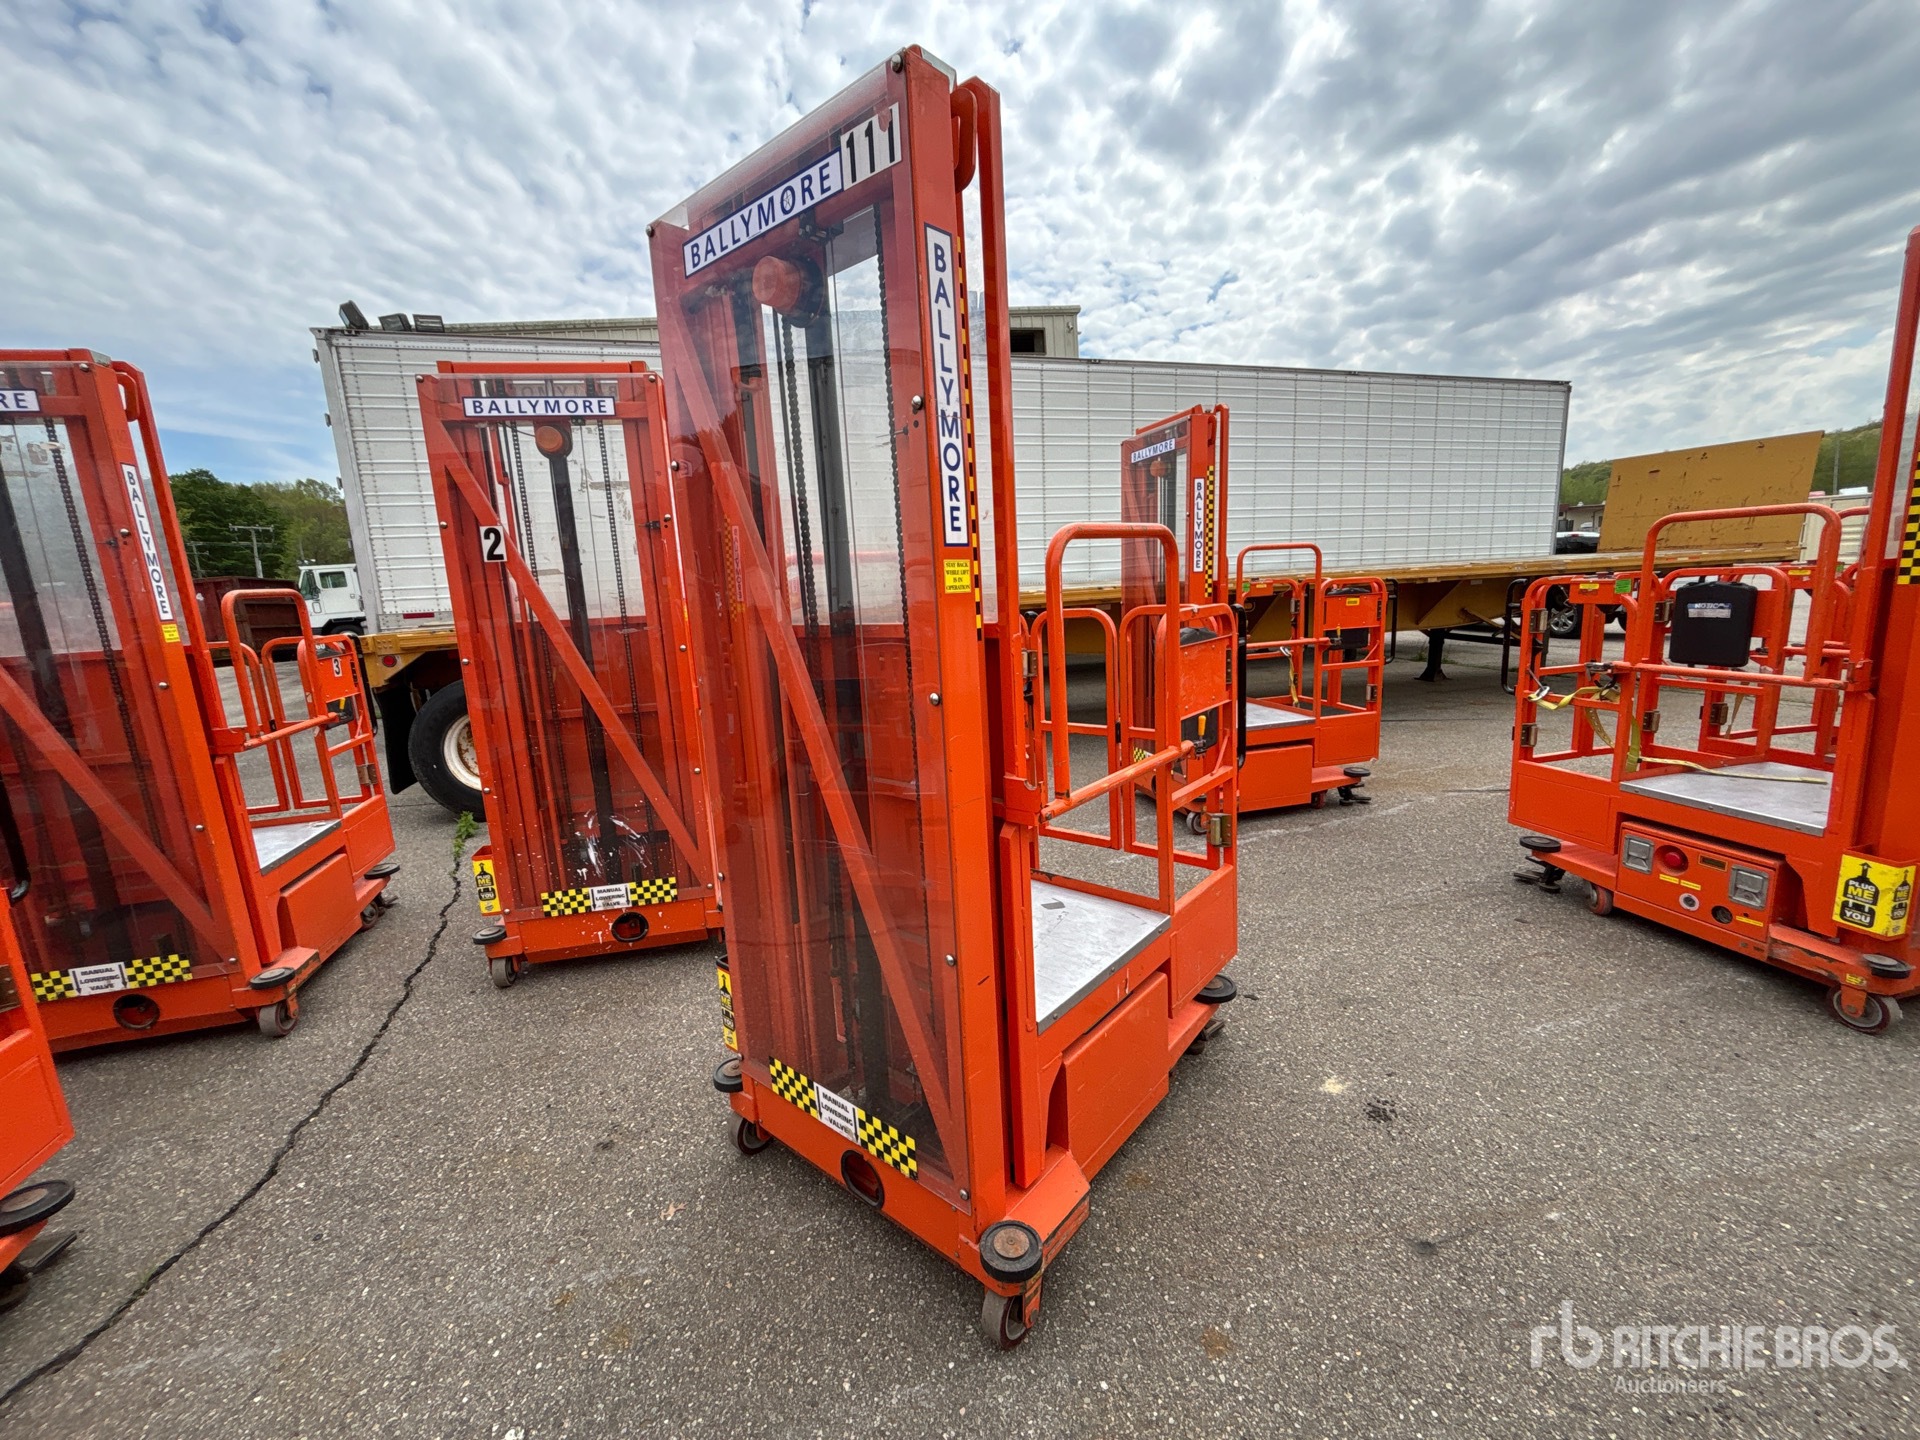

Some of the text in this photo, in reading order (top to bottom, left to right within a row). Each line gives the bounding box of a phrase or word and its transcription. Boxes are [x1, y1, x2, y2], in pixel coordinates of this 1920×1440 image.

[690, 162, 832, 269] BALLYMORE
[934, 242, 962, 532] BALLYMORE
[472, 399, 608, 414] BALLYMORE
[1132, 440, 1174, 462] BALLYMORE
[1194, 481, 1203, 569] BALLYMORE
[126, 470, 169, 615] BALLYMORE
[483, 527, 505, 561] 2
[333, 658, 341, 675] 3
[477, 878, 492, 886] ME
[1848, 879, 1876, 892] PLUG
[1847, 886, 1875, 901] ME
[1844, 910, 1871, 923] YOU
[80, 974, 120, 985] LOWERING
[81, 967, 115, 976] MANUAL
[89, 983, 114, 991] VALVE
[822, 1092, 850, 1114] MANUAL
[821, 1102, 853, 1127] LOWERING
